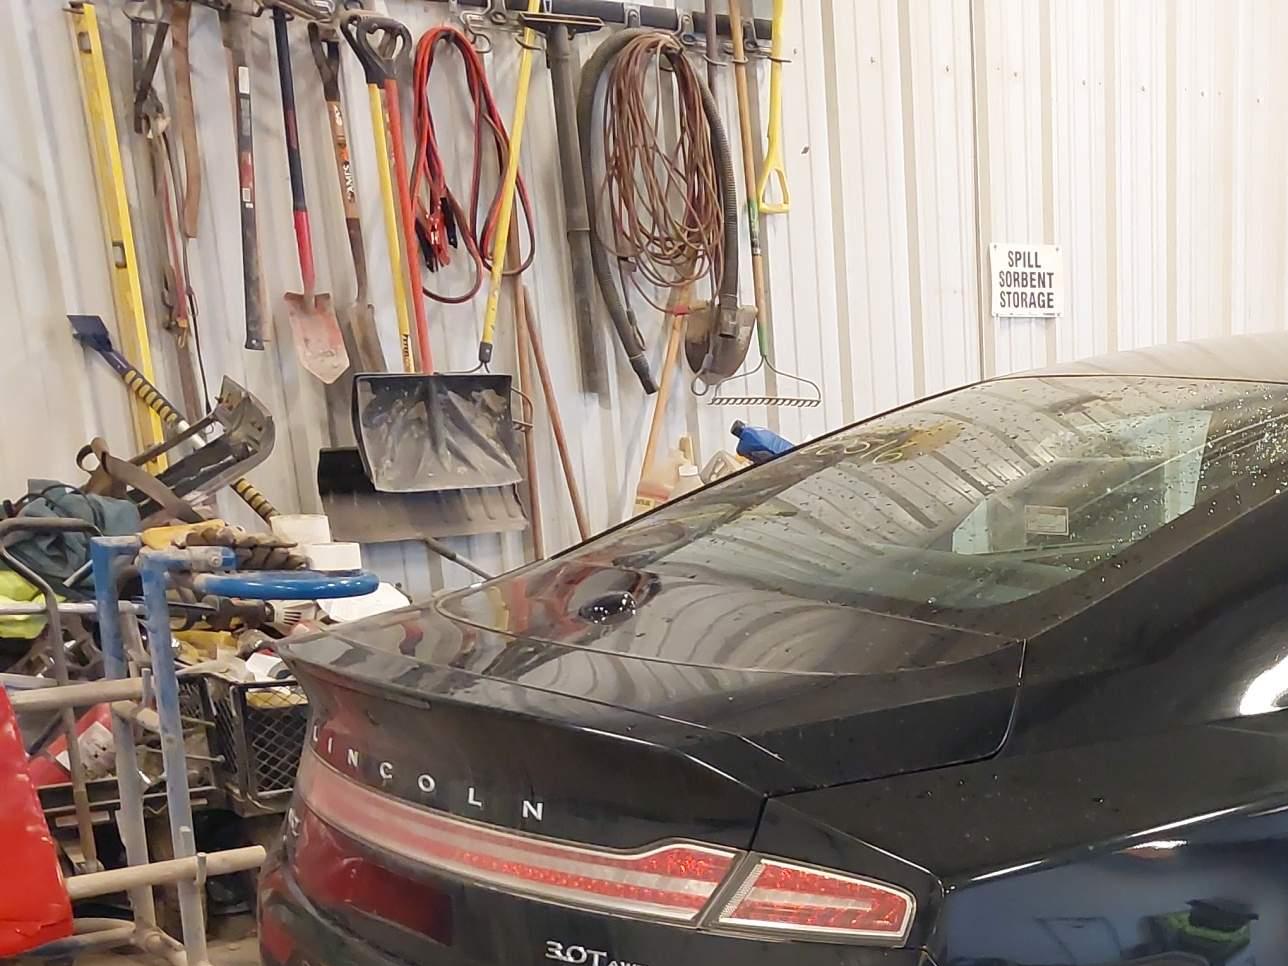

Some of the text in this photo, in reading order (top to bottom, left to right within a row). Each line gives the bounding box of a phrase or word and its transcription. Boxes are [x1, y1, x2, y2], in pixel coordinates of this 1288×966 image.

[1007, 250, 1041, 268] SPILL
[999, 270, 1054, 288] SORBENT
[999, 290, 1054, 308] STORAGE
[312, 725, 544, 821] LINCOLN
